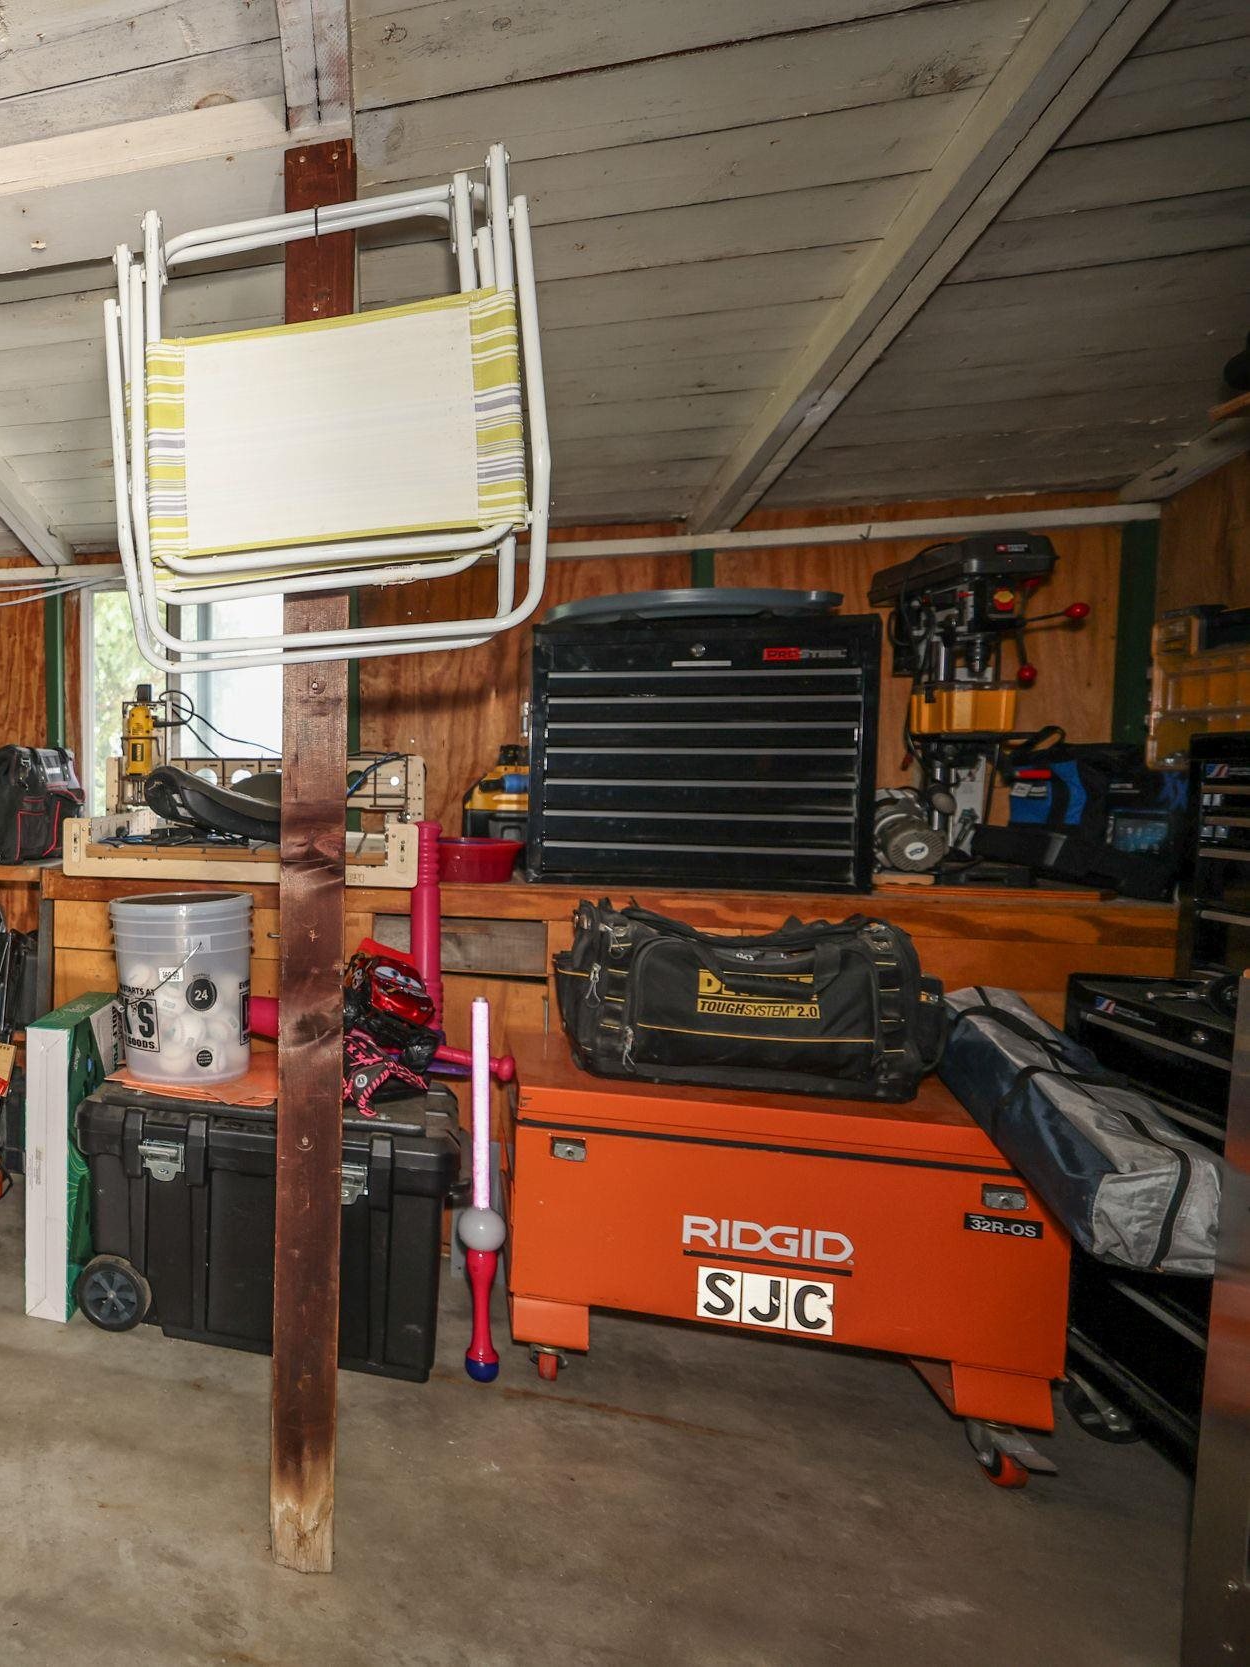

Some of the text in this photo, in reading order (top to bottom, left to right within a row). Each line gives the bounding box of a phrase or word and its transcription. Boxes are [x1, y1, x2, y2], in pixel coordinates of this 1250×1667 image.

[194, 989, 209, 1001] 24
[700, 1000, 818, 1018] TOUGHSYSTEM 2.0
[971, 1219, 1037, 1238] 32R-OS
[682, 1215, 854, 1263] RIDGID
[703, 1272, 827, 1330] SJC
